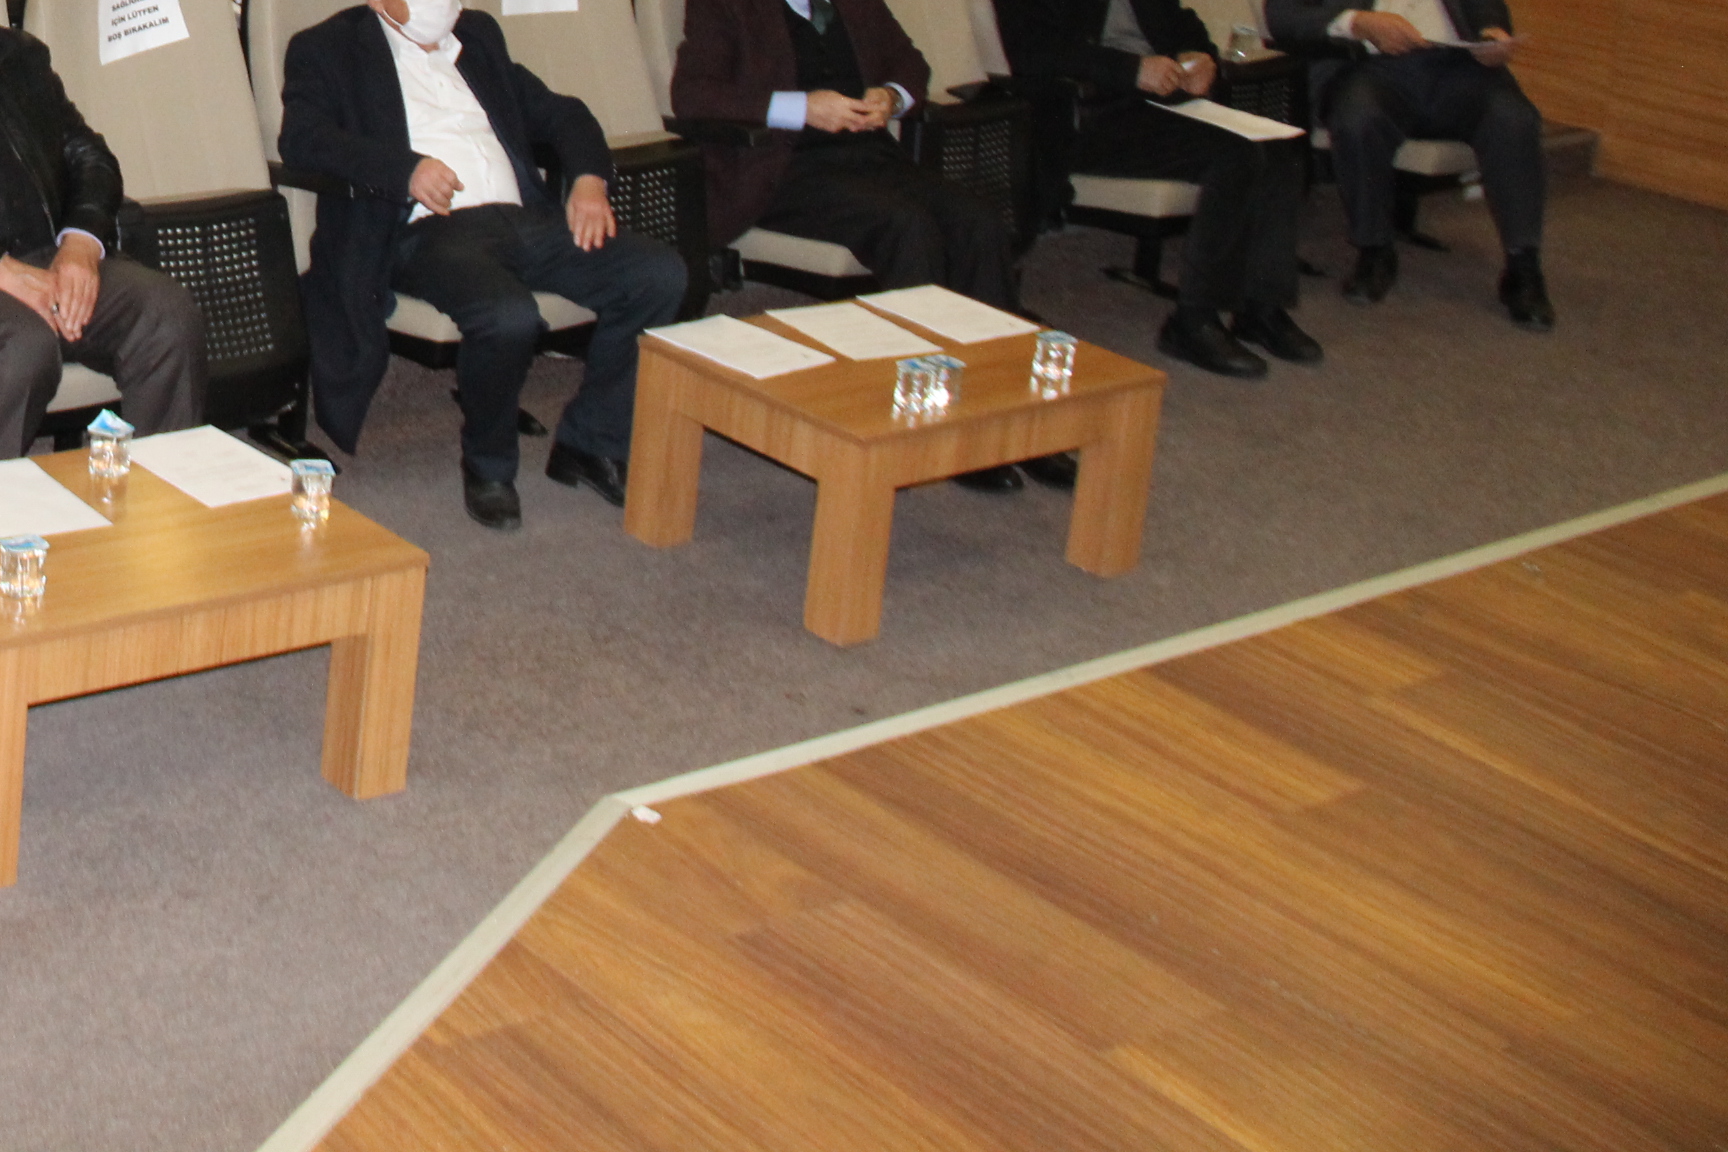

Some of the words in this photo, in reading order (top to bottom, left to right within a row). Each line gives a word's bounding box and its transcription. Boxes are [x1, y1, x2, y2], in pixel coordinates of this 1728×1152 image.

[111, 16, 126, 26] İÇİN
[127, 4, 159, 21] LÜTFEN
[107, 32, 122, 42] BOŞ
[123, 17, 169, 37] BIRAKALIM
